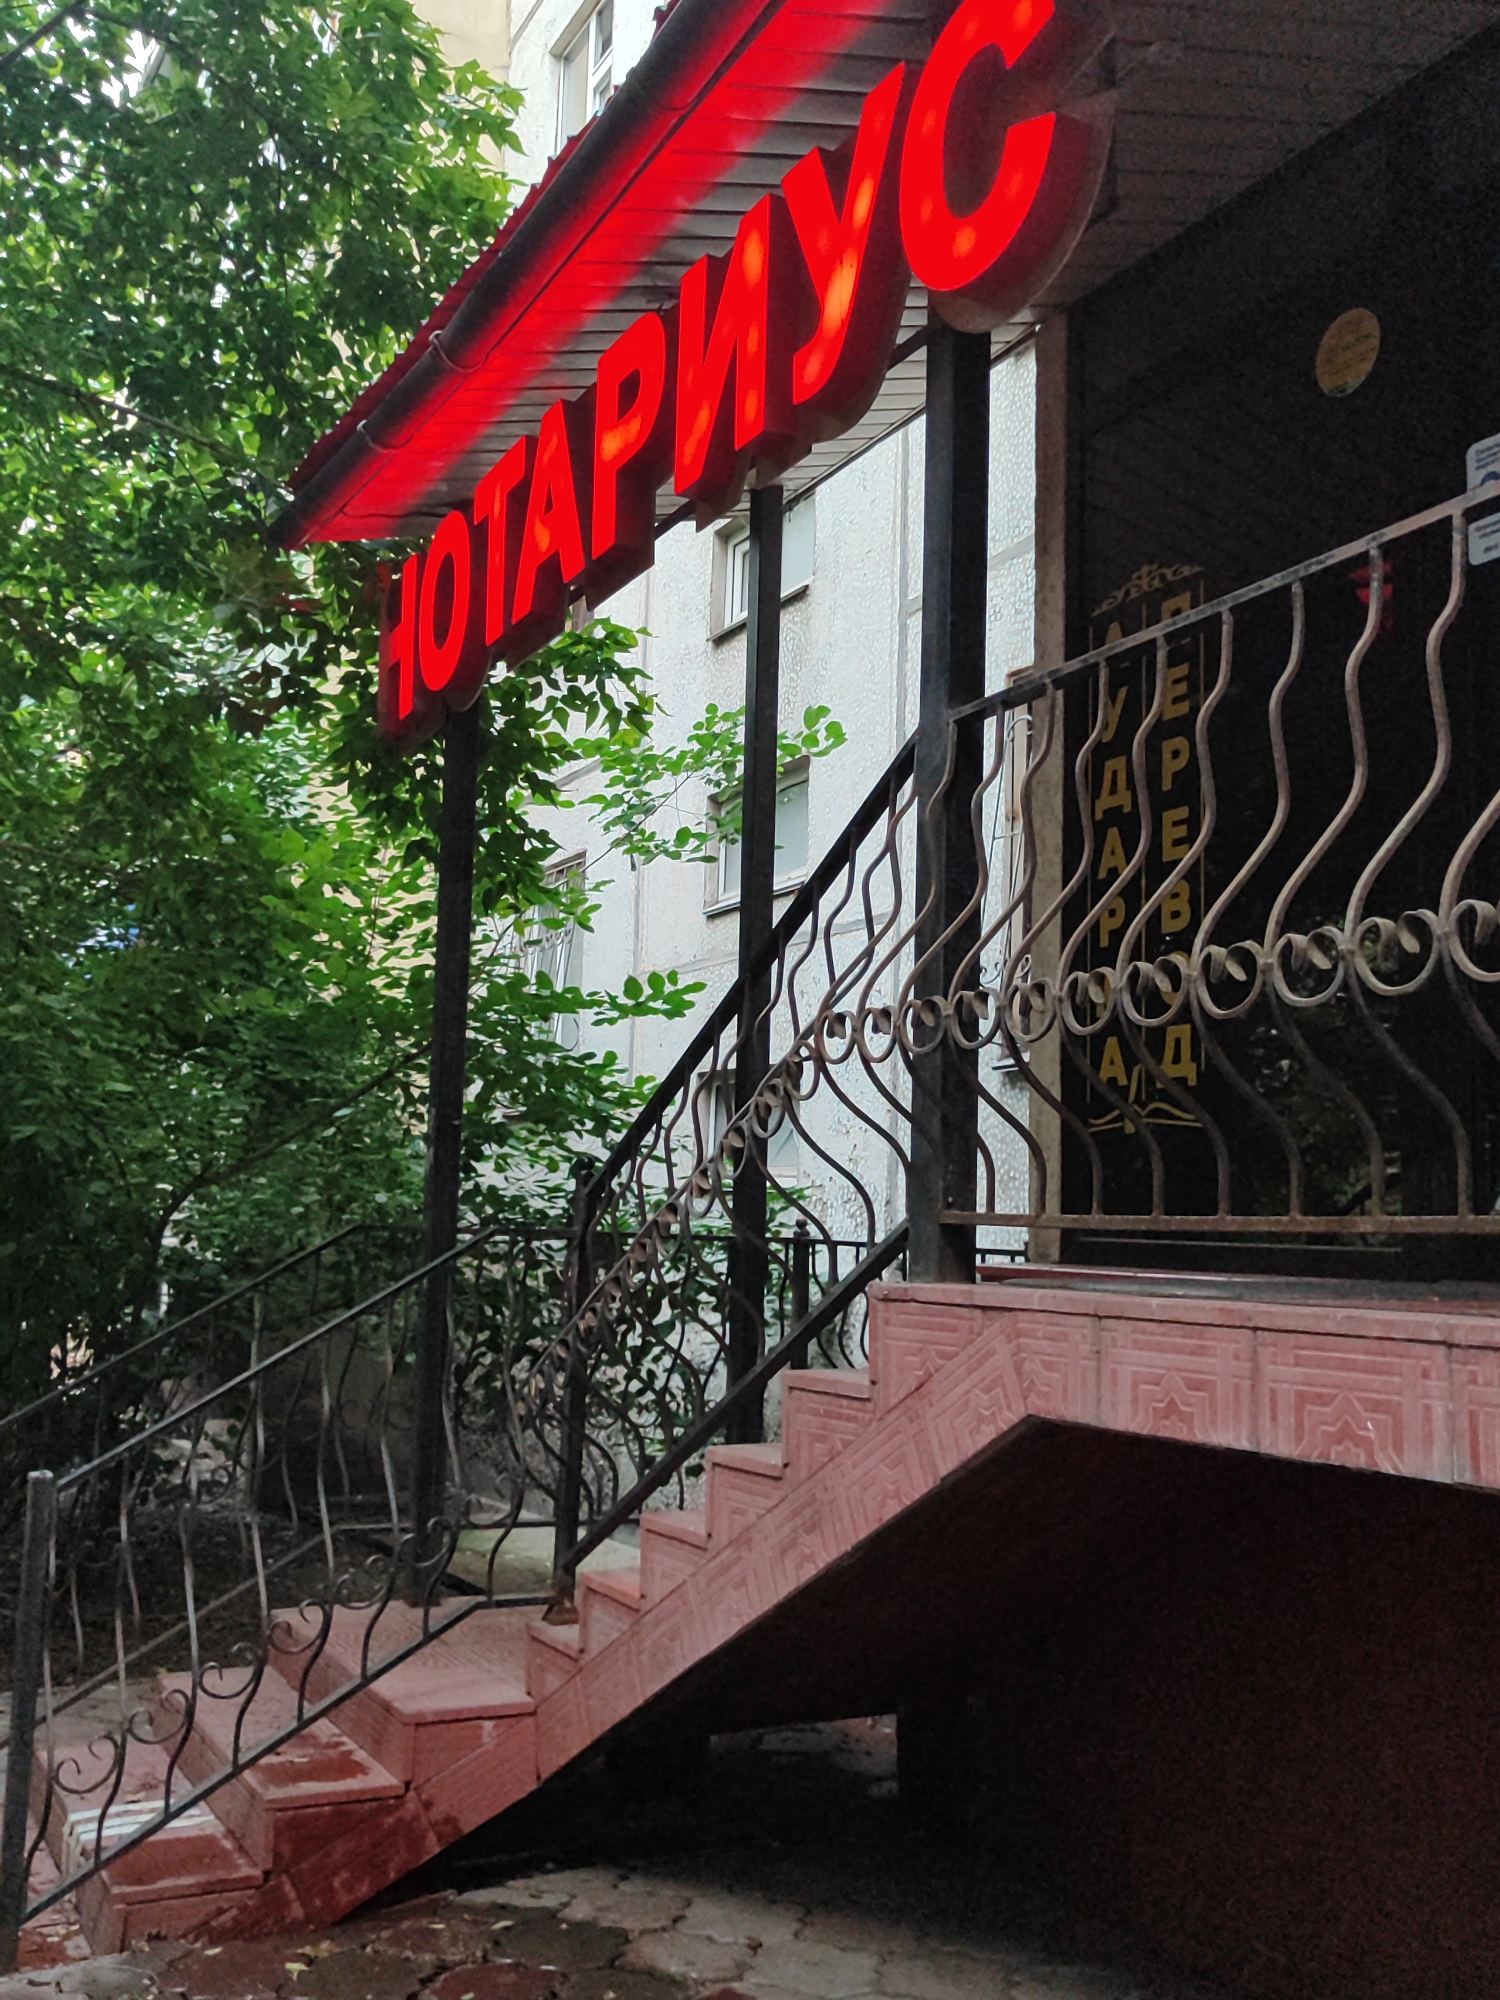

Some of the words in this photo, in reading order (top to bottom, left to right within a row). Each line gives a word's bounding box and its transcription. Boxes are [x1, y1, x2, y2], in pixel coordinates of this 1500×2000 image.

[377, 0, 1056, 720] НОТАРИУС
[1095, 621, 1133, 1087] АУДАРА
[1156, 591, 1197, 1088] ПЕРЕВД
